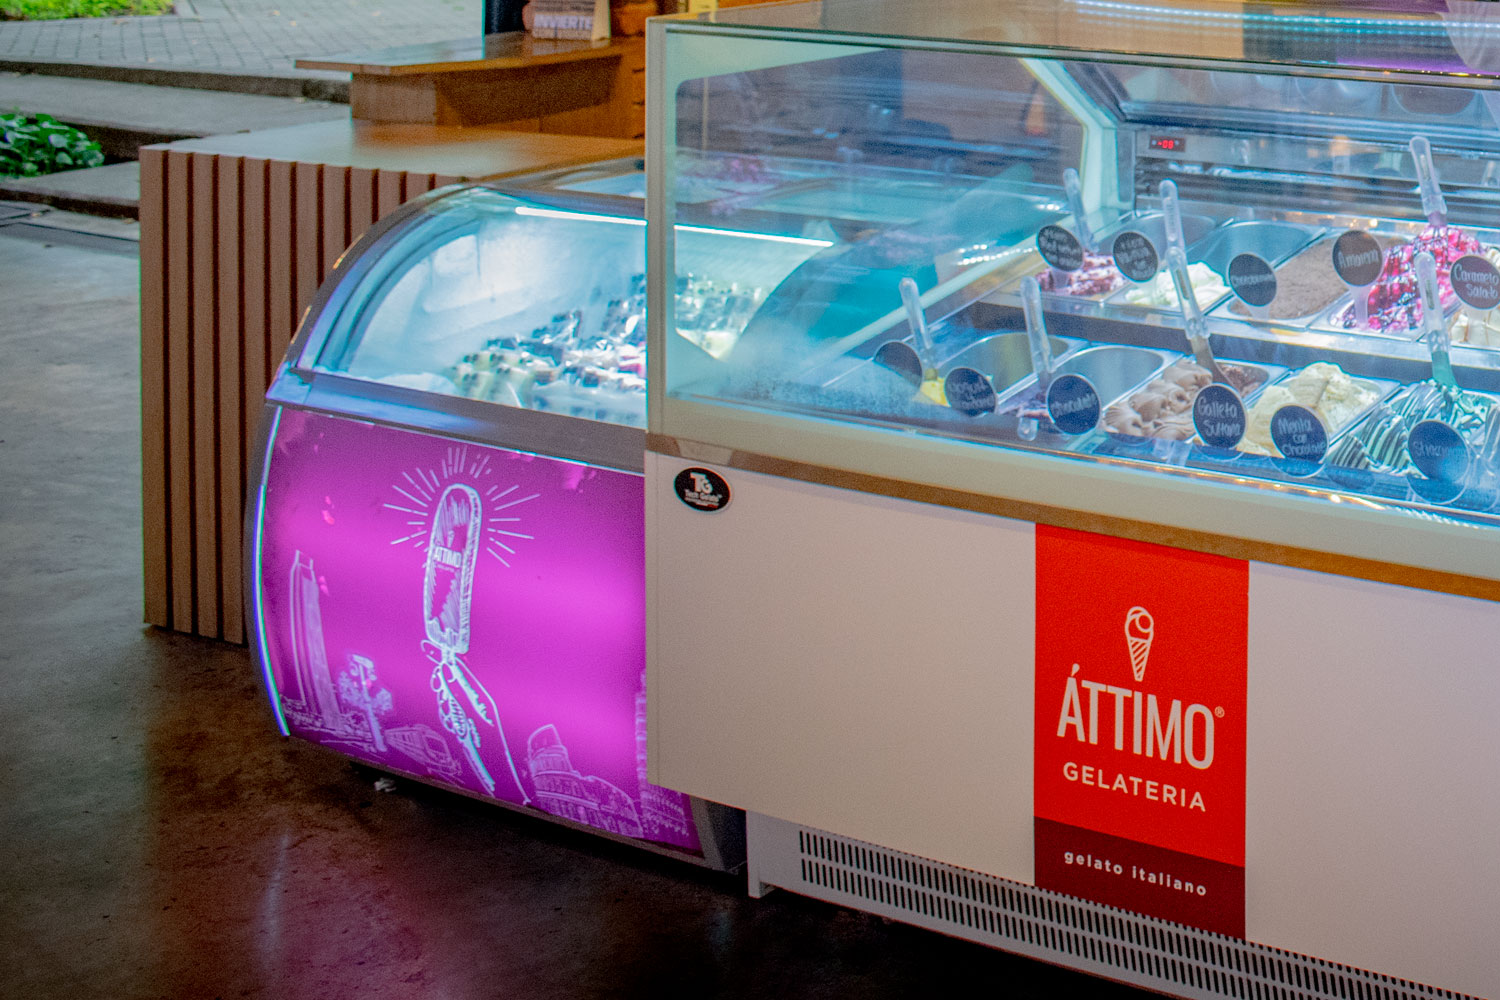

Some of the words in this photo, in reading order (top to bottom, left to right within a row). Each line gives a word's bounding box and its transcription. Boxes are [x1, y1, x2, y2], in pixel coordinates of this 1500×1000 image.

[1197, 396, 1239, 419] Galleta
[1277, 417, 1313, 436] Menta
[1063, 761, 1207, 813] GELATERIA
[1064, 850, 1124, 876] gelato
[1132, 865, 1208, 897] italiano
